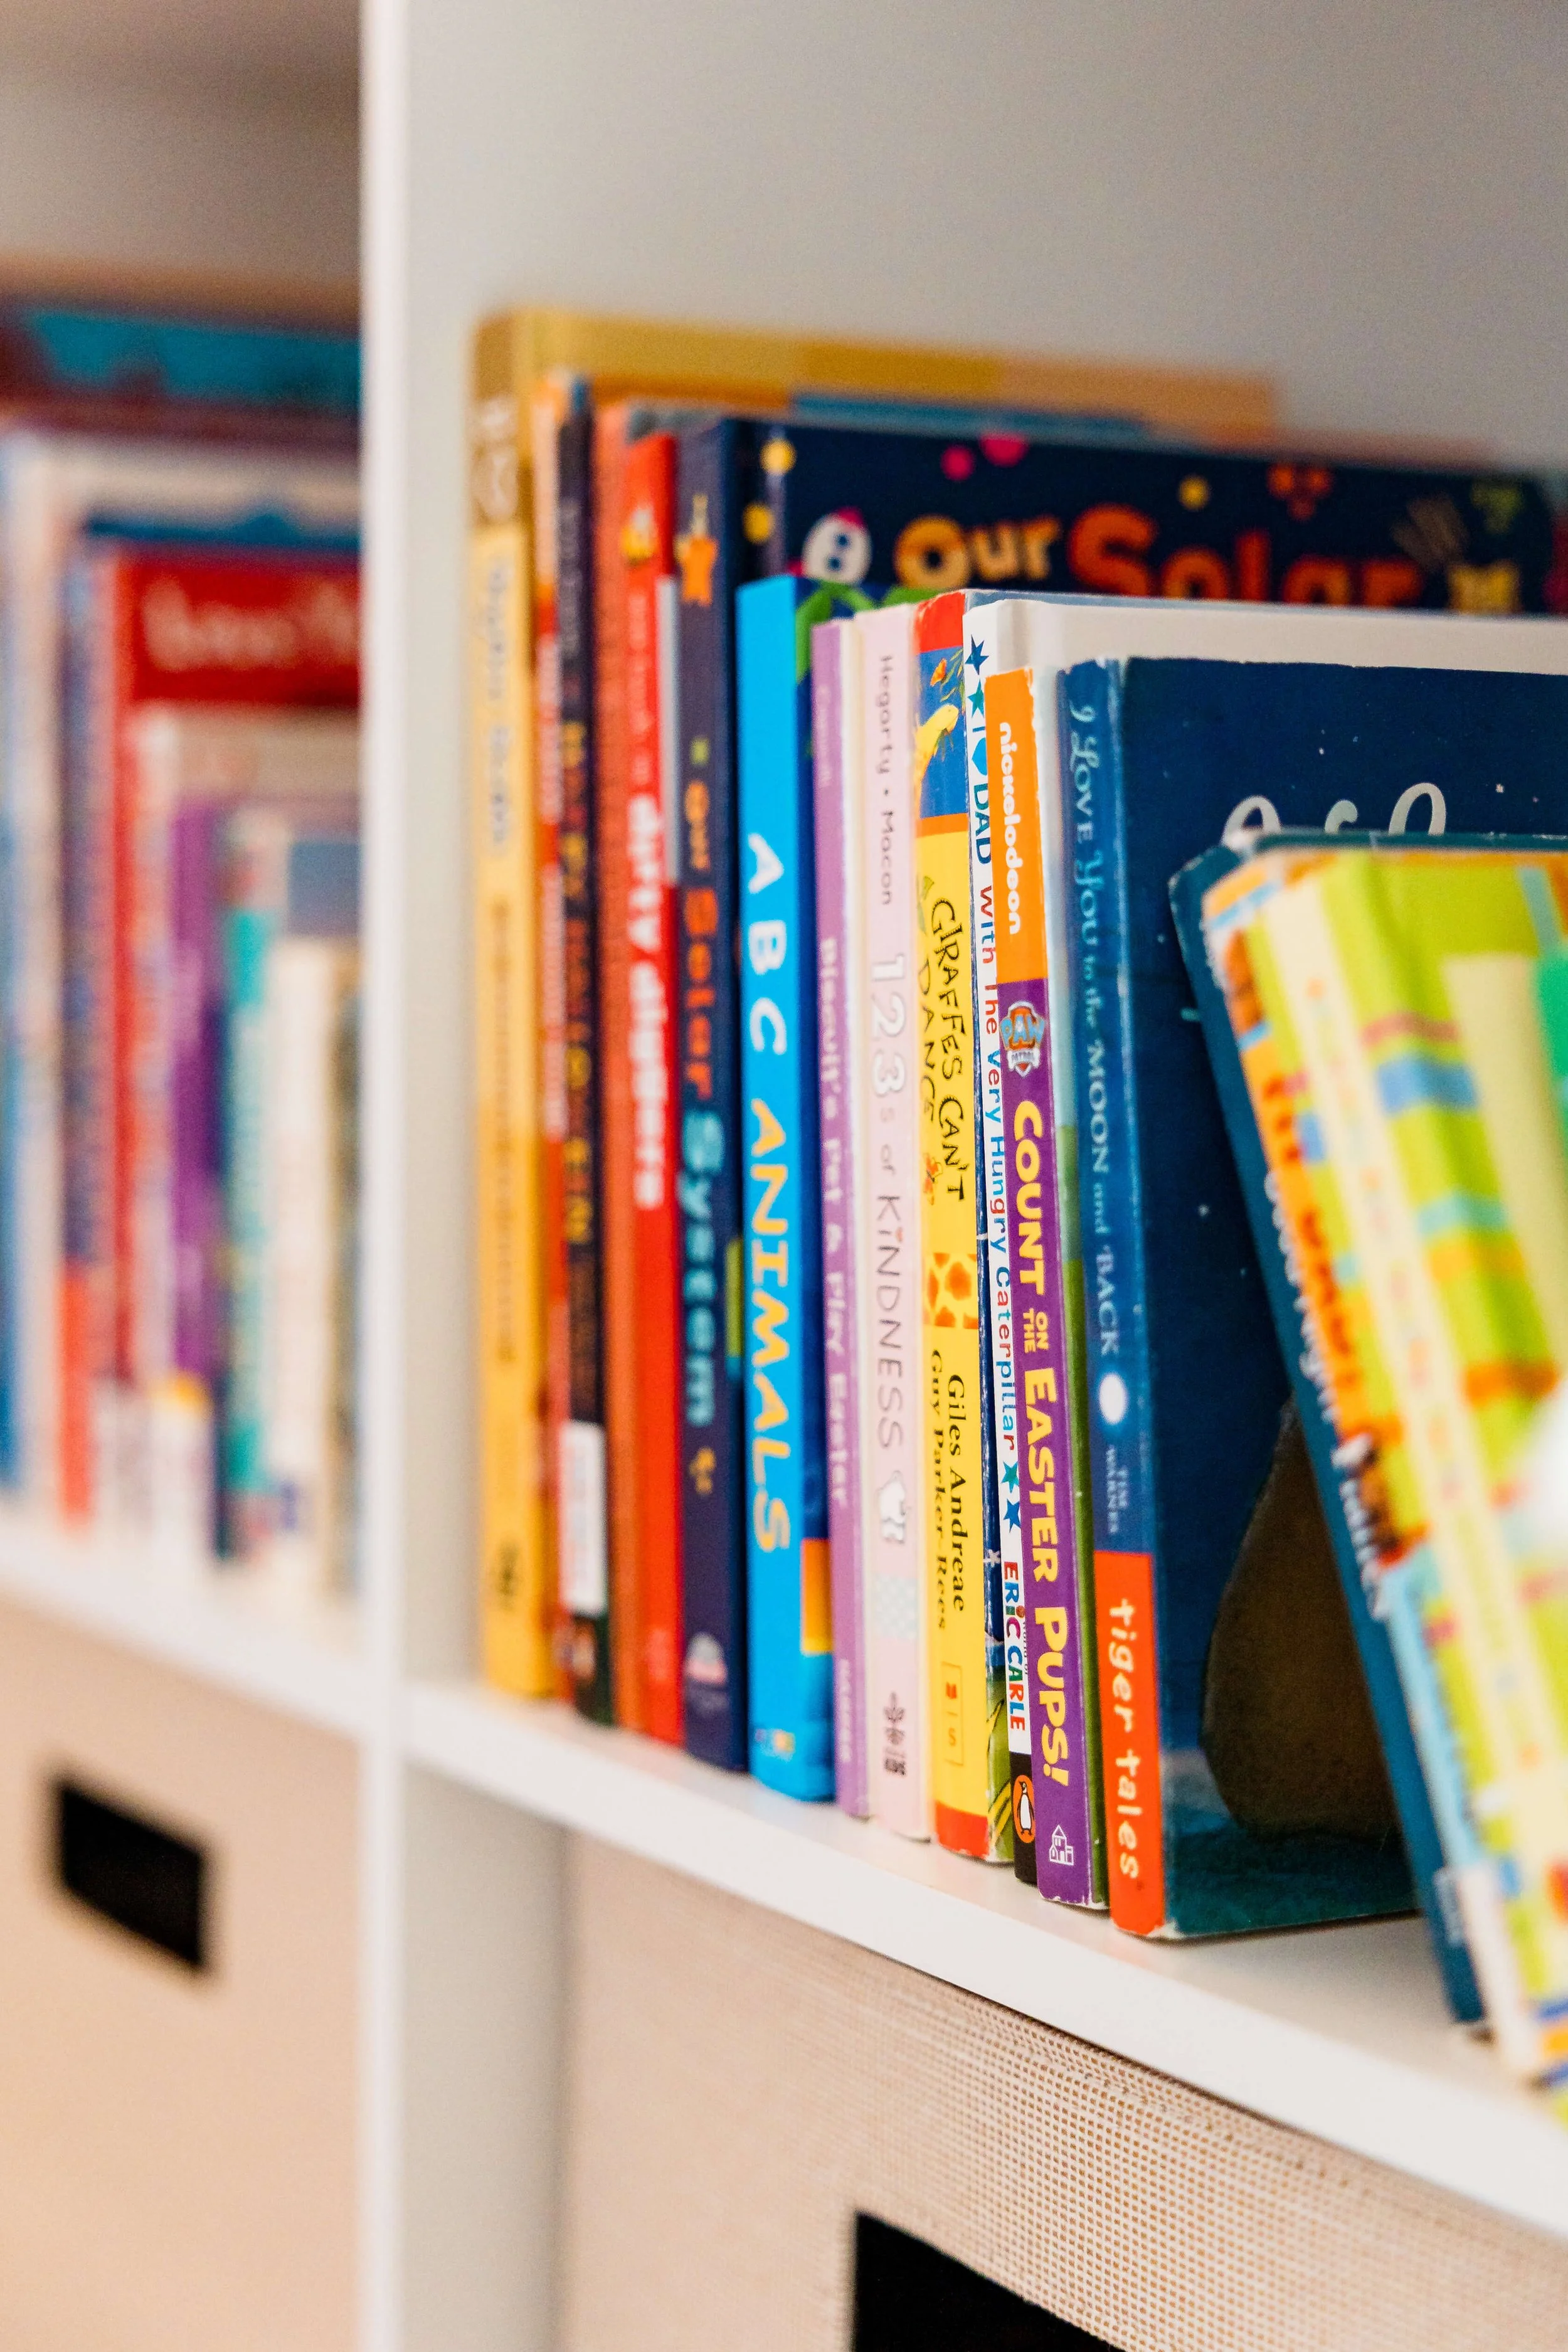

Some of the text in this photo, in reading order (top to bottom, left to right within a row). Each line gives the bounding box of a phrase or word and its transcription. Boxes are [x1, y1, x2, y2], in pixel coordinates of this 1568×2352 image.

[895, 504, 1419, 606] Our Solar
[876, 654, 895, 905] Hegarty Macon
[975, 783, 993, 864] DAD
[1000, 721, 1023, 935] nickelodeon
[685, 886, 719, 1099] Solar
[931, 898, 967, 1080] GIRAFFES
[985, 984, 999, 1034] The
[1083, 955, 1097, 980] to
[1085, 987, 1104, 1029] the
[985, 1049, 1002, 1123] Very
[1000, 1014, 1046, 1049] PAW
[880, 1143, 896, 1175] of
[1087, 1039, 1110, 1174] MOON
[989, 1136, 1009, 1251] Hungry
[1093, 1181, 1110, 1234] and
[677, 1108, 725, 1426] System
[1094, 1245, 1120, 1357] BACK
[752, 1098, 792, 1552] ANIMALS
[995, 1266, 1017, 1450] Caterpillar
[929, 1349, 943, 1416] Guy
[948, 1374, 969, 1612] Giles Andreae
[1014, 1100, 1069, 1787] COUNT ON THE EASTER PUPS!
[1007, 1645, 1025, 1731] CARLE
[1109, 1597, 1143, 1879] tiger tales
